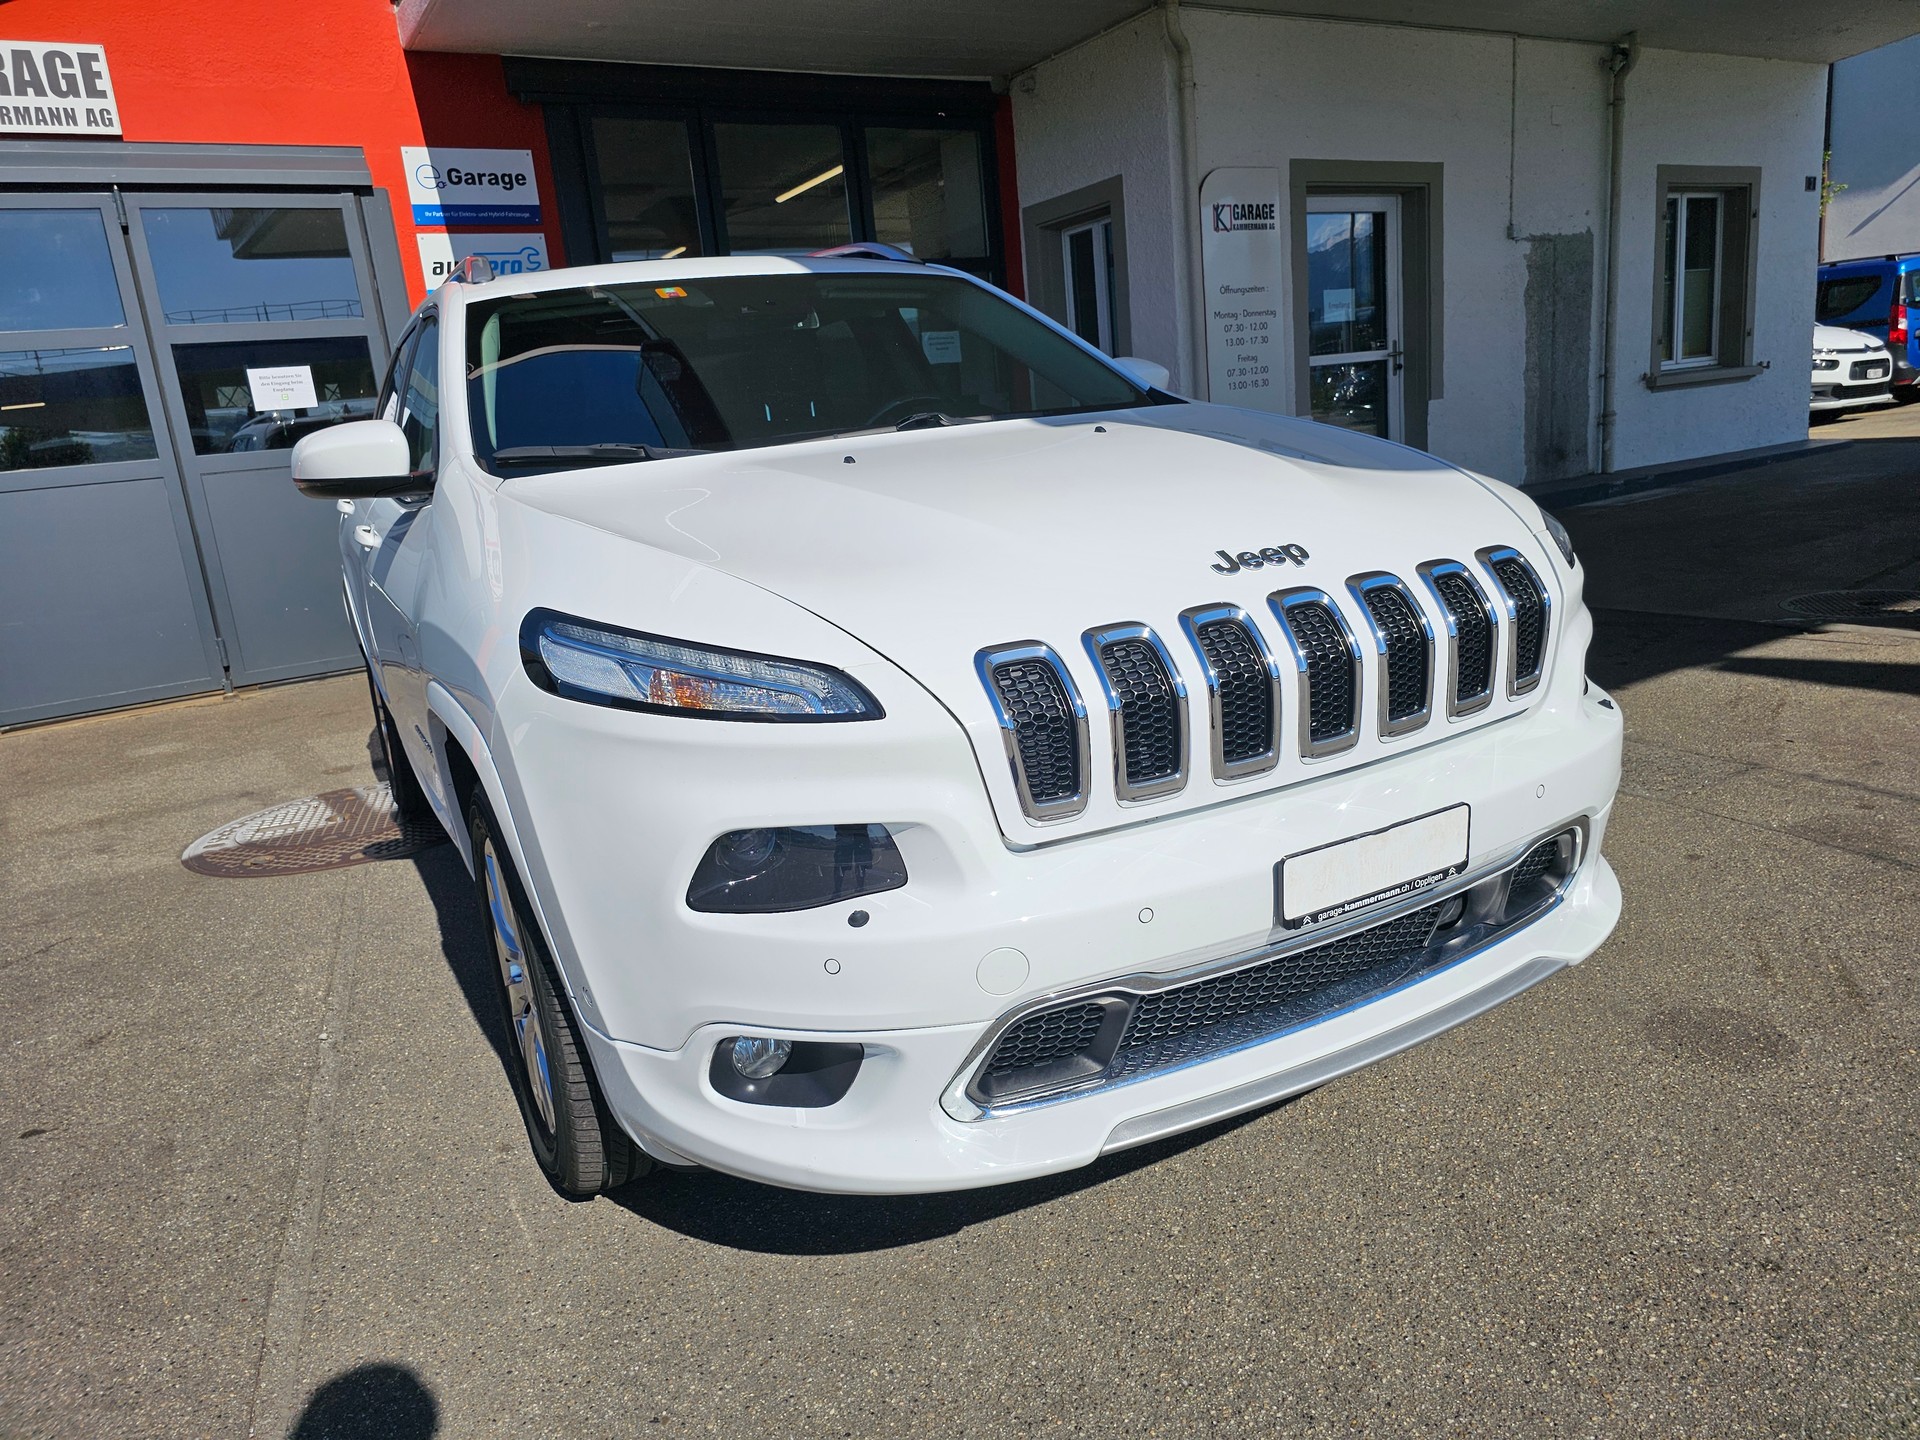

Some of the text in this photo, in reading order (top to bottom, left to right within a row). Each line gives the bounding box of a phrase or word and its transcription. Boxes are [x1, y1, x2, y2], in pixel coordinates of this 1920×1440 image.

[86, 108, 114, 127] AG
[1233, 203, 1275, 221] GARAGE
[1233, 222, 1276, 231] KAMMERMANN AG
[1213, 311, 1239, 321] Montag
[1242, 309, 1277, 319] Donnerstag
[1223, 323, 1245, 333] 07.30
[1249, 322, 1268, 331] 12.00
[1225, 337, 1245, 347] 13.00
[1250, 336, 1269, 345] 17.30
[1237, 354, 1258, 363] Freitag
[1226, 368, 1247, 378] 07.30
[1228, 381, 1248, 390] 13.00
[1210, 543, 1310, 576] Jeep
[1317, 883, 1410, 921] garage-kammermann.ch
[1414, 872, 1443, 889] Oppligen
